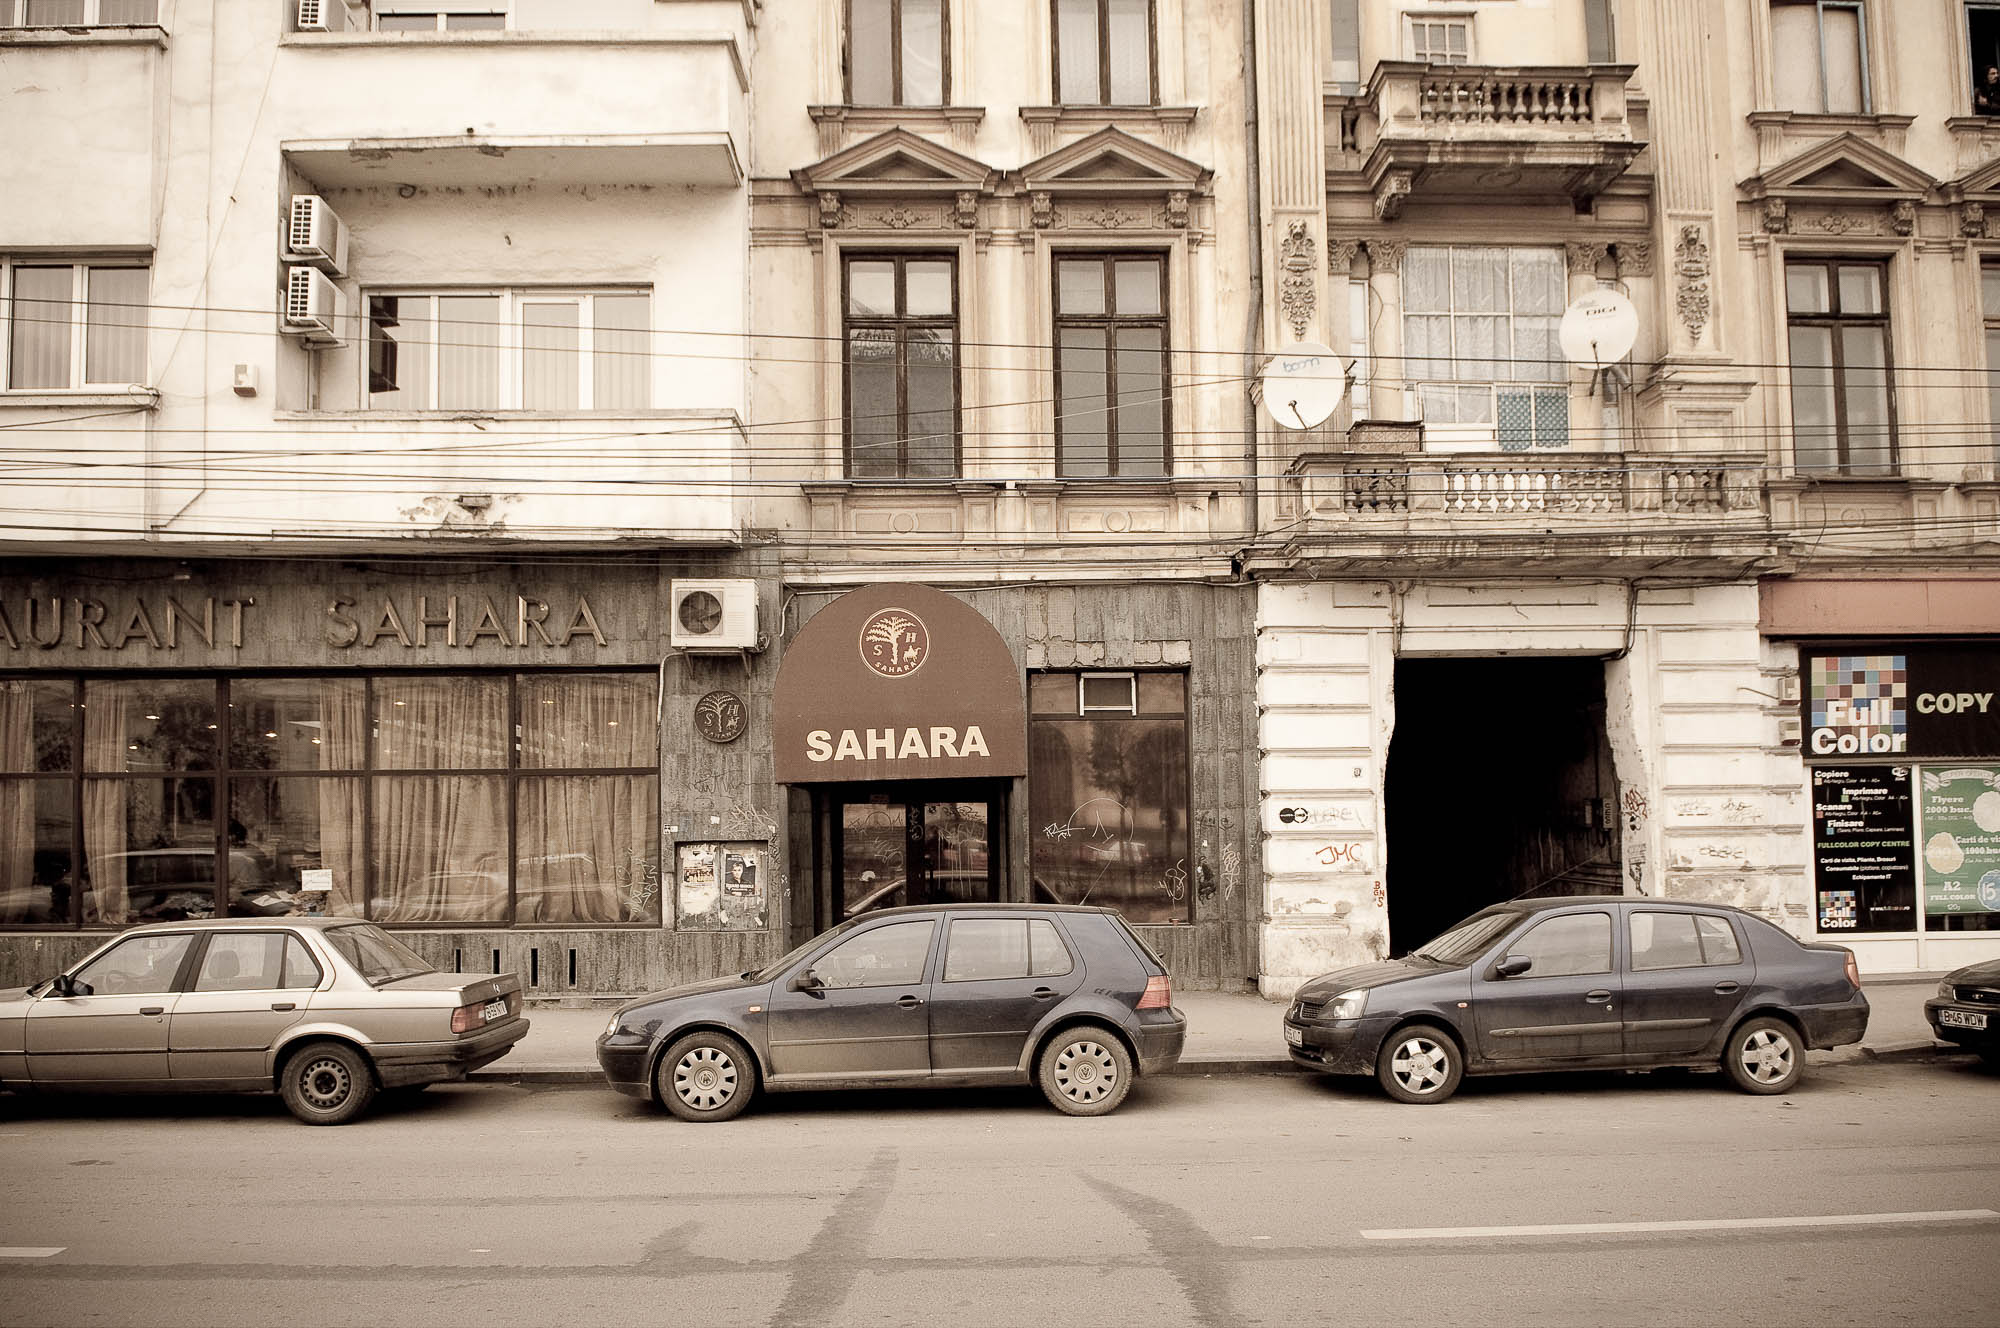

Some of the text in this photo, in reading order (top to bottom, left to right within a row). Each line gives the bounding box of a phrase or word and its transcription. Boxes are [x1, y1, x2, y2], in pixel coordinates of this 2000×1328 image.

[326, 594, 608, 648] SAHARA
[875, 661, 917, 673] SAHARA
[1916, 692, 1994, 714] COPY
[1826, 699, 1892, 726] Full
[806, 725, 991, 762] SAHARA
[1811, 727, 1907, 755] Color
[1814, 770, 1850, 779] Copiere
[1842, 787, 1888, 796] Imprimare
[1815, 803, 1853, 811] Scanare
[1925, 806, 1948, 814] 2000
[1827, 819, 1864, 828] Finisare
[1943, 881, 1961, 891] A2
[1820, 917, 1857, 928] Color
